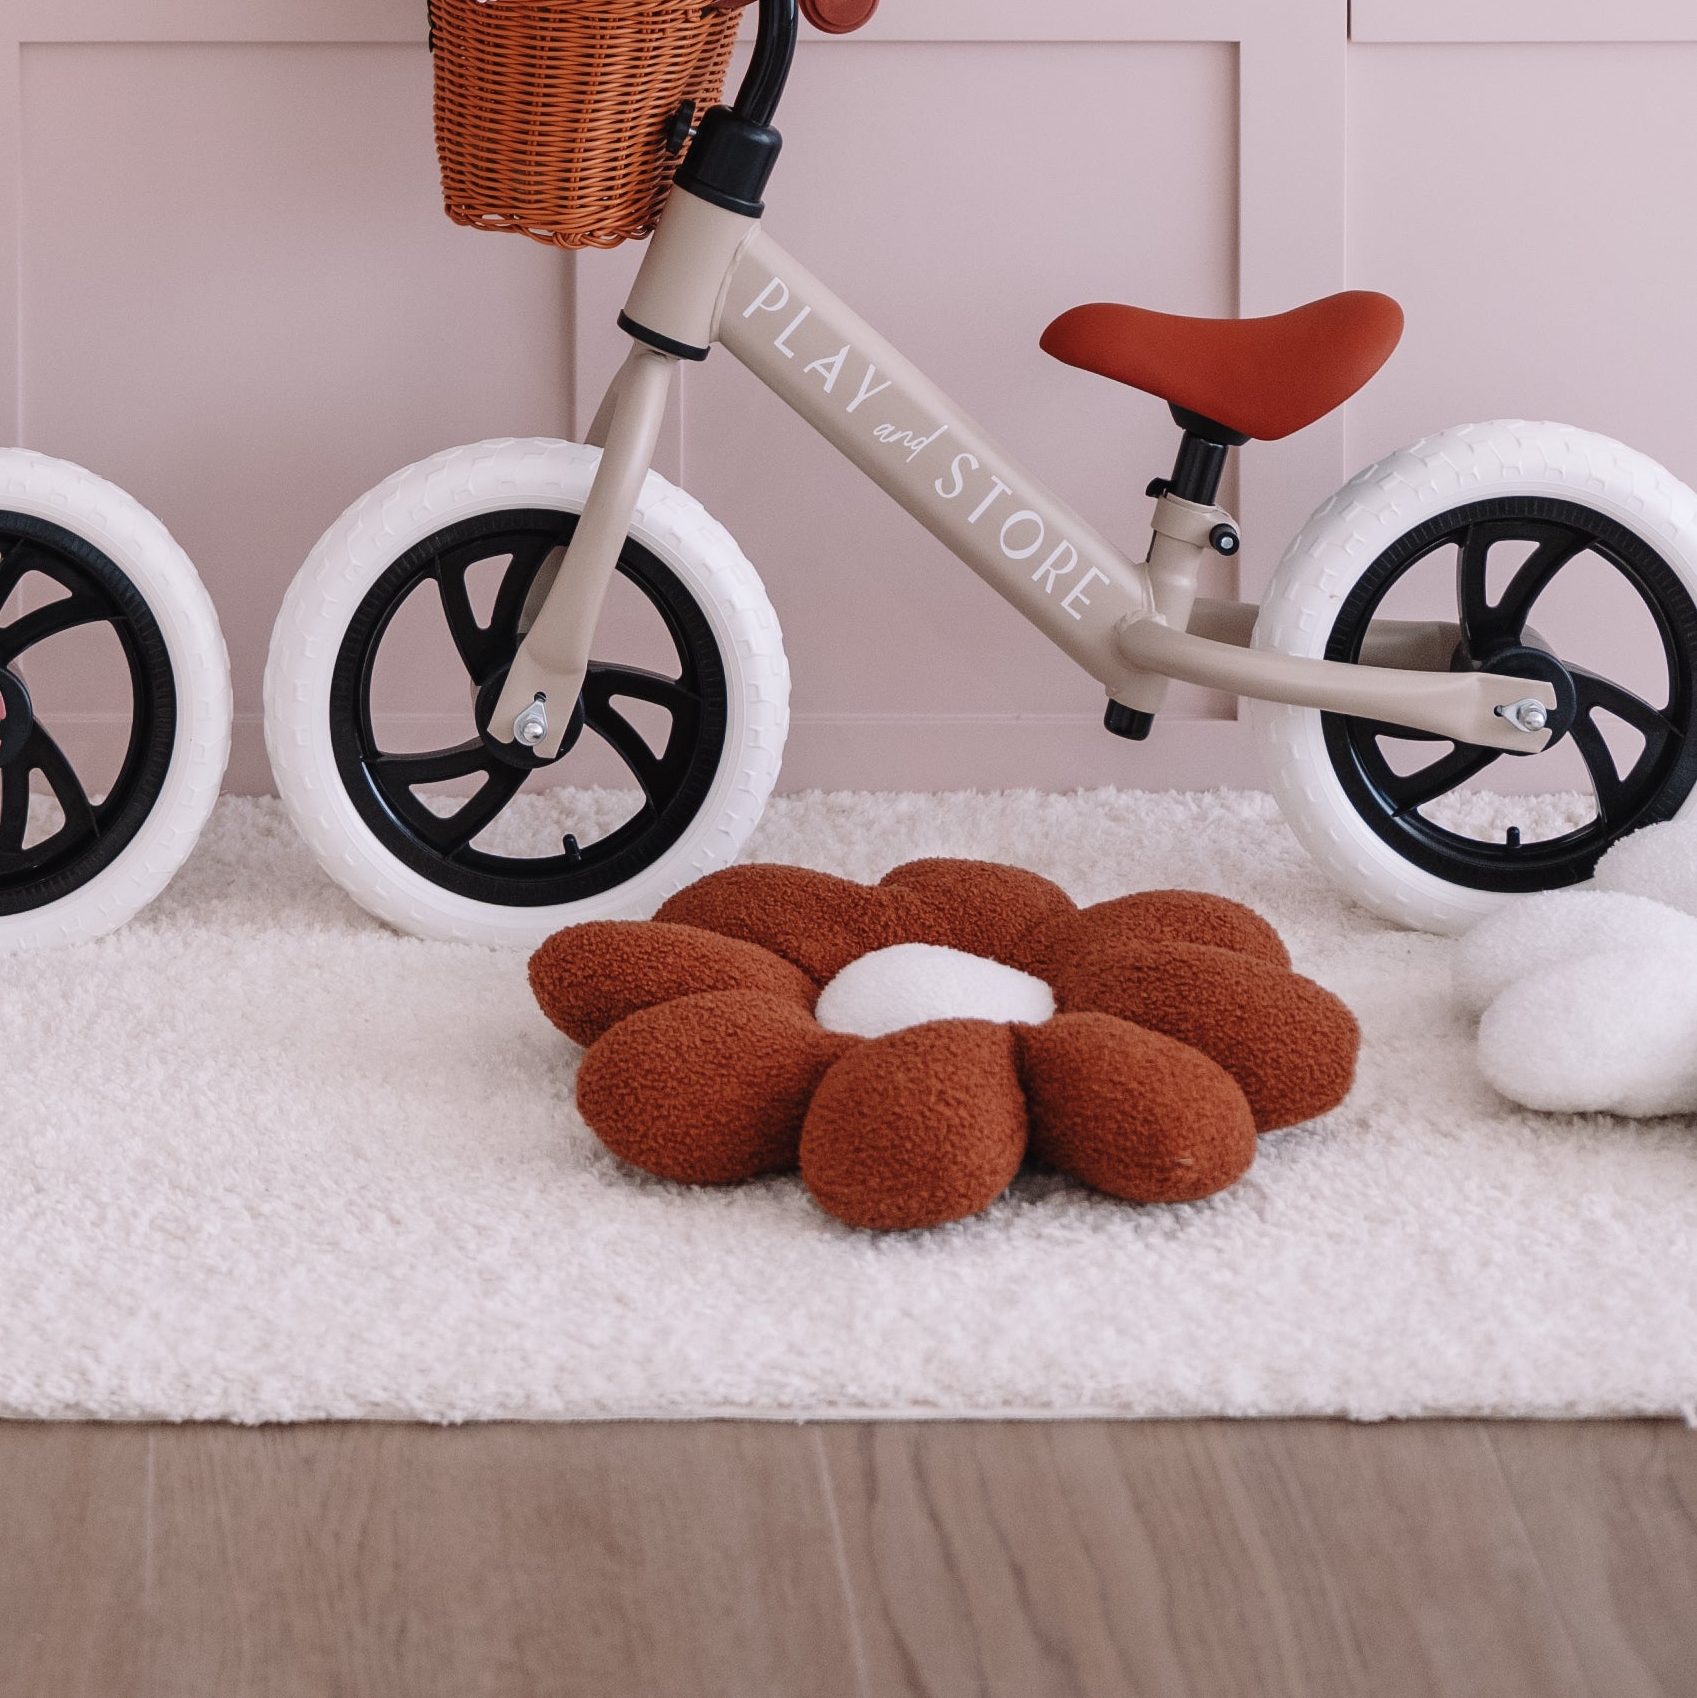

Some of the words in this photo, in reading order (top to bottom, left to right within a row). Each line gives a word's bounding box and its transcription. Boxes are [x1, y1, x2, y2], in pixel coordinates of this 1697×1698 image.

[742, 276, 893, 414] PLAY
[872, 423, 949, 463] and
[934, 452, 1111, 621] STORE
